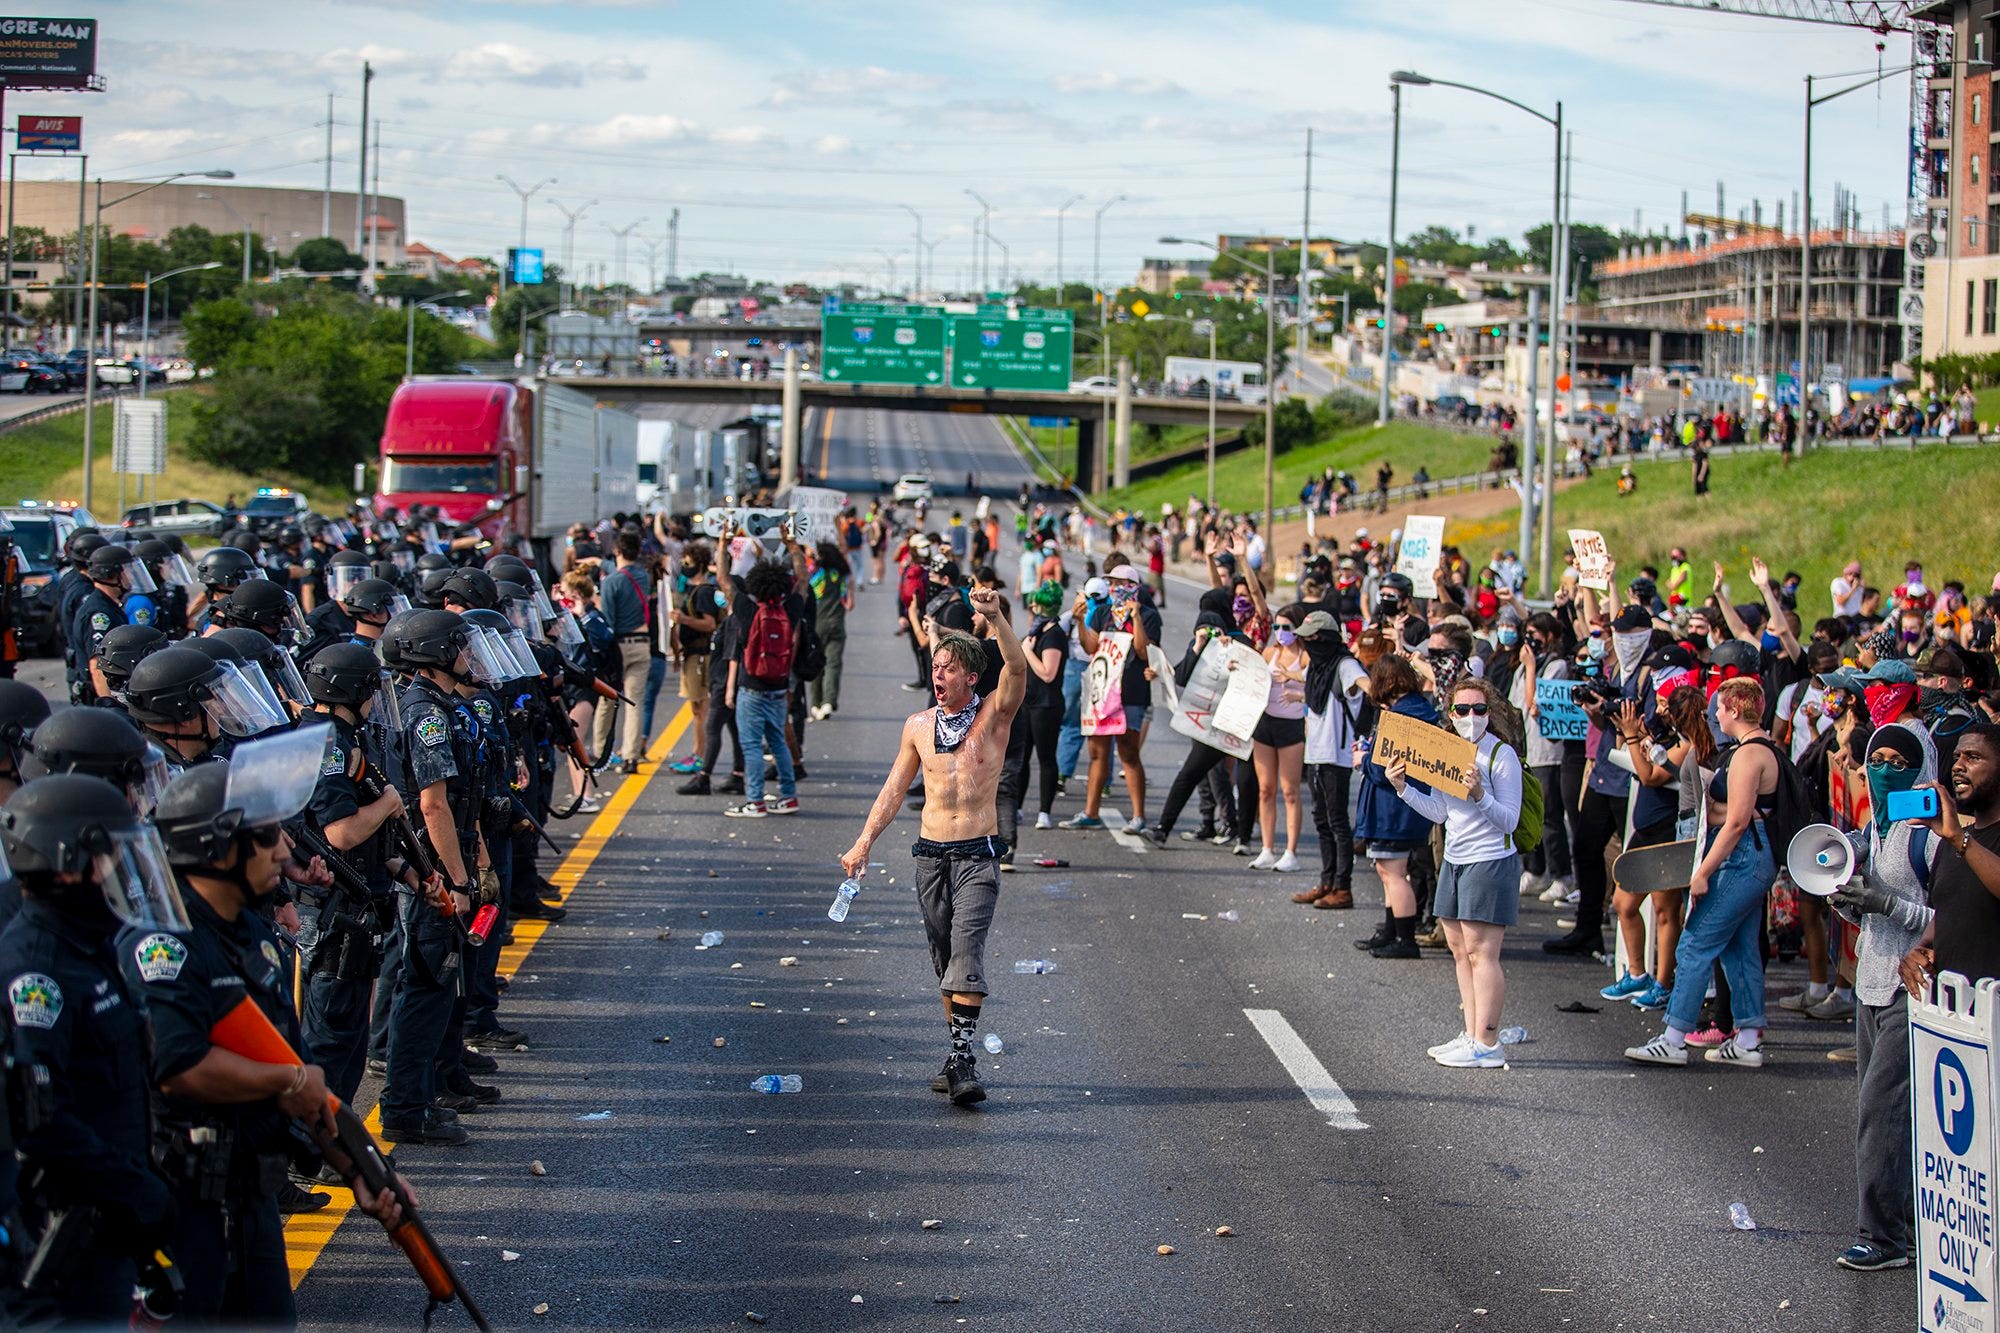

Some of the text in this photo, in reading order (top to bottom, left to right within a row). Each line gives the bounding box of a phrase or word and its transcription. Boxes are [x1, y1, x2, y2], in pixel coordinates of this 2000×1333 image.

[0, 20, 90, 39] GRE-MAN
[35, 120, 64, 131] AVIS
[1184, 690, 1217, 731] ALL
[1541, 703, 1579, 715] TO THE
[416, 717, 443, 731] POLICE
[1540, 715, 1588, 737] BADGE
[139, 936, 184, 953] POLICE
[14, 976, 61, 1000] POLICE
[1925, 1151, 1987, 1207] PAY THE
[1921, 1187, 1991, 1248] MACHINE
[1939, 1232, 1978, 1277] ONLY
